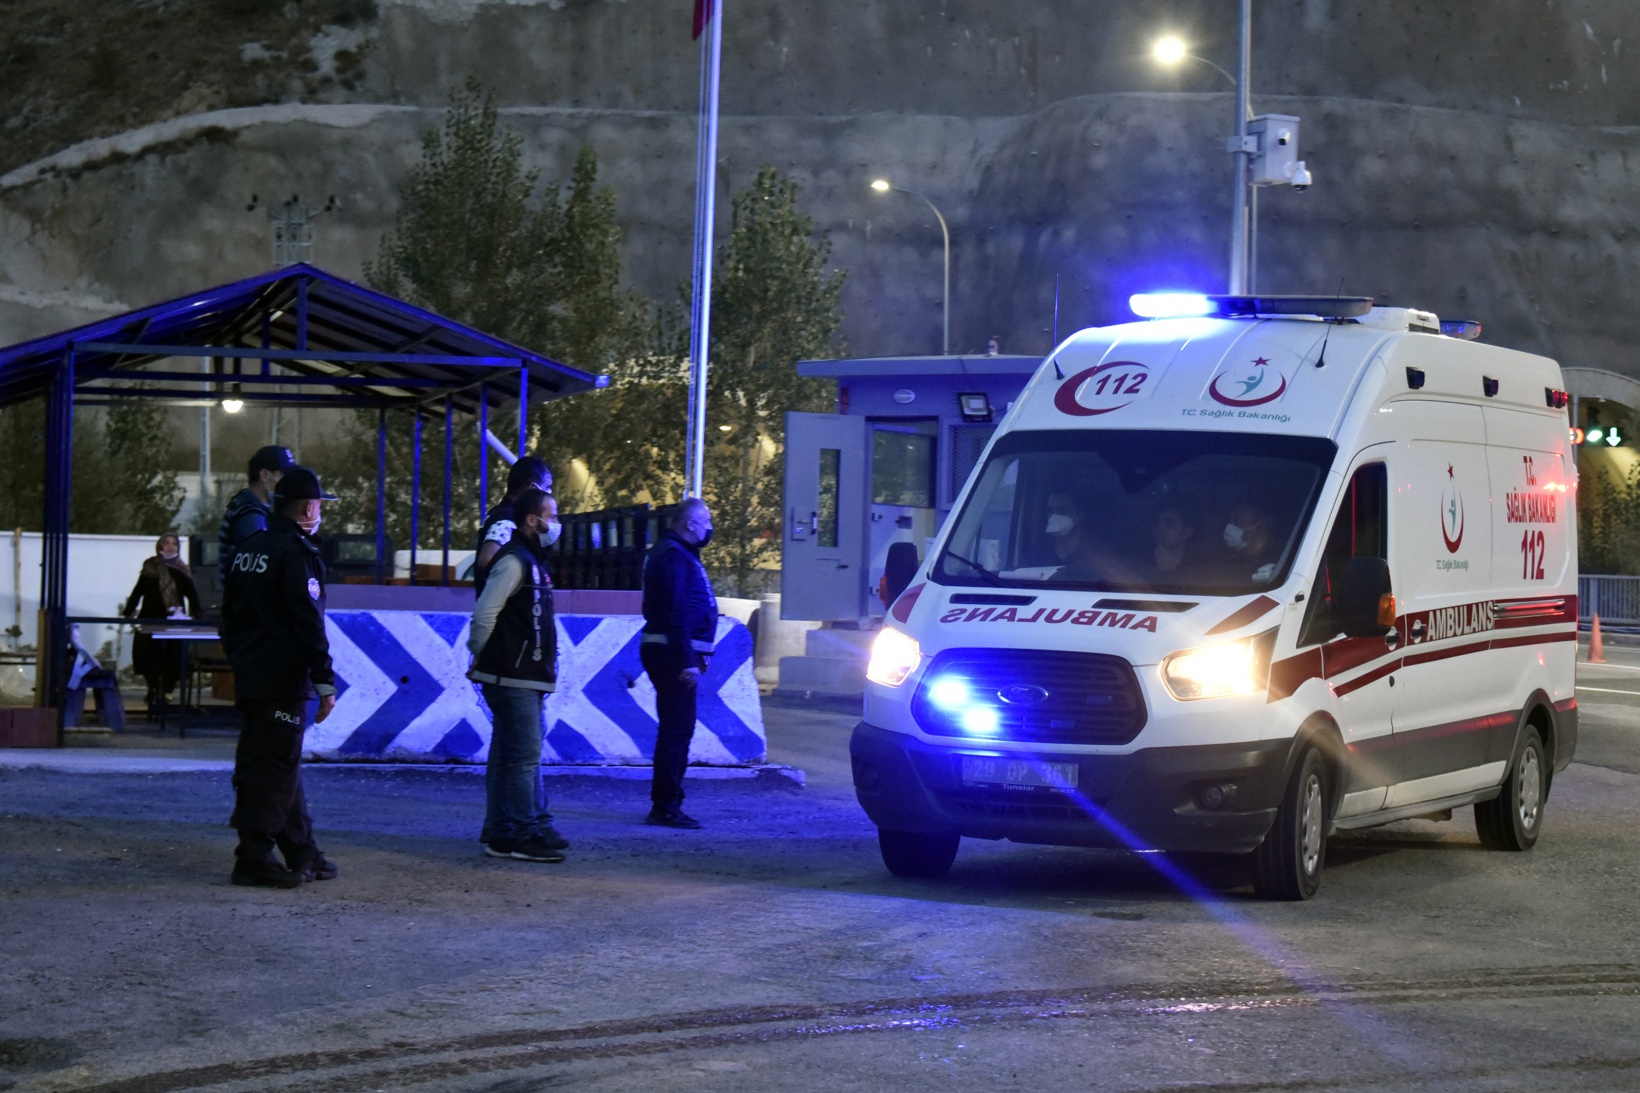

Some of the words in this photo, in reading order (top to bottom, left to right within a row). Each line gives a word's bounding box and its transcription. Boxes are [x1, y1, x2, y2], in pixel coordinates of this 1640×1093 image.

[1094, 372, 1149, 396] 112
[1521, 530, 1545, 580] 112
[1426, 600, 1495, 642] AMBULANS
